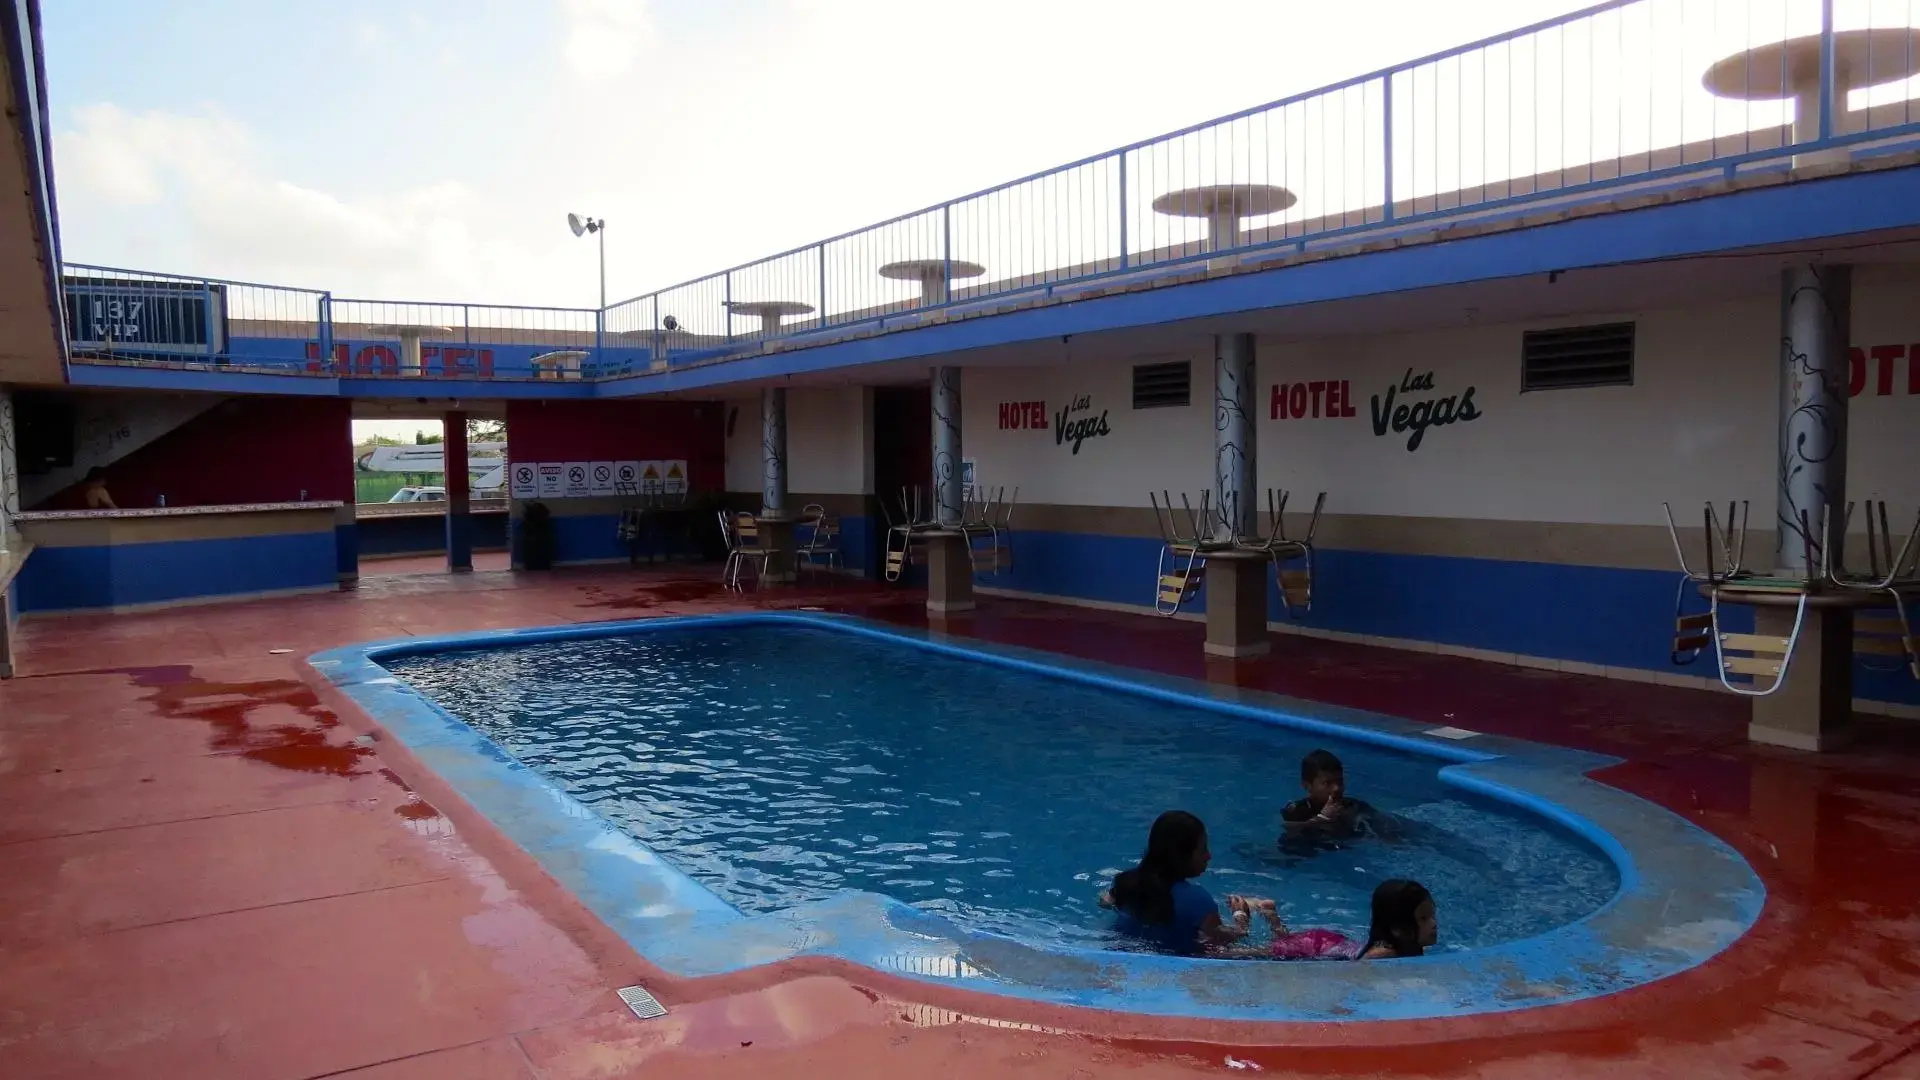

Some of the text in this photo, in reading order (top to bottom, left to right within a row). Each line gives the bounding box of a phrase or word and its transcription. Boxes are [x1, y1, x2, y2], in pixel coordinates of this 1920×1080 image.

[94, 301, 143, 320] 137
[93, 324, 139, 337] VIP
[1400, 367, 1435, 393] Las
[1071, 393, 1091, 412] Las
[1270, 380, 1356, 420] HOTEL
[999, 401, 1048, 429] HOTEL
[1370, 384, 1482, 452] Vegas
[1055, 405, 1111, 455] Vegas
